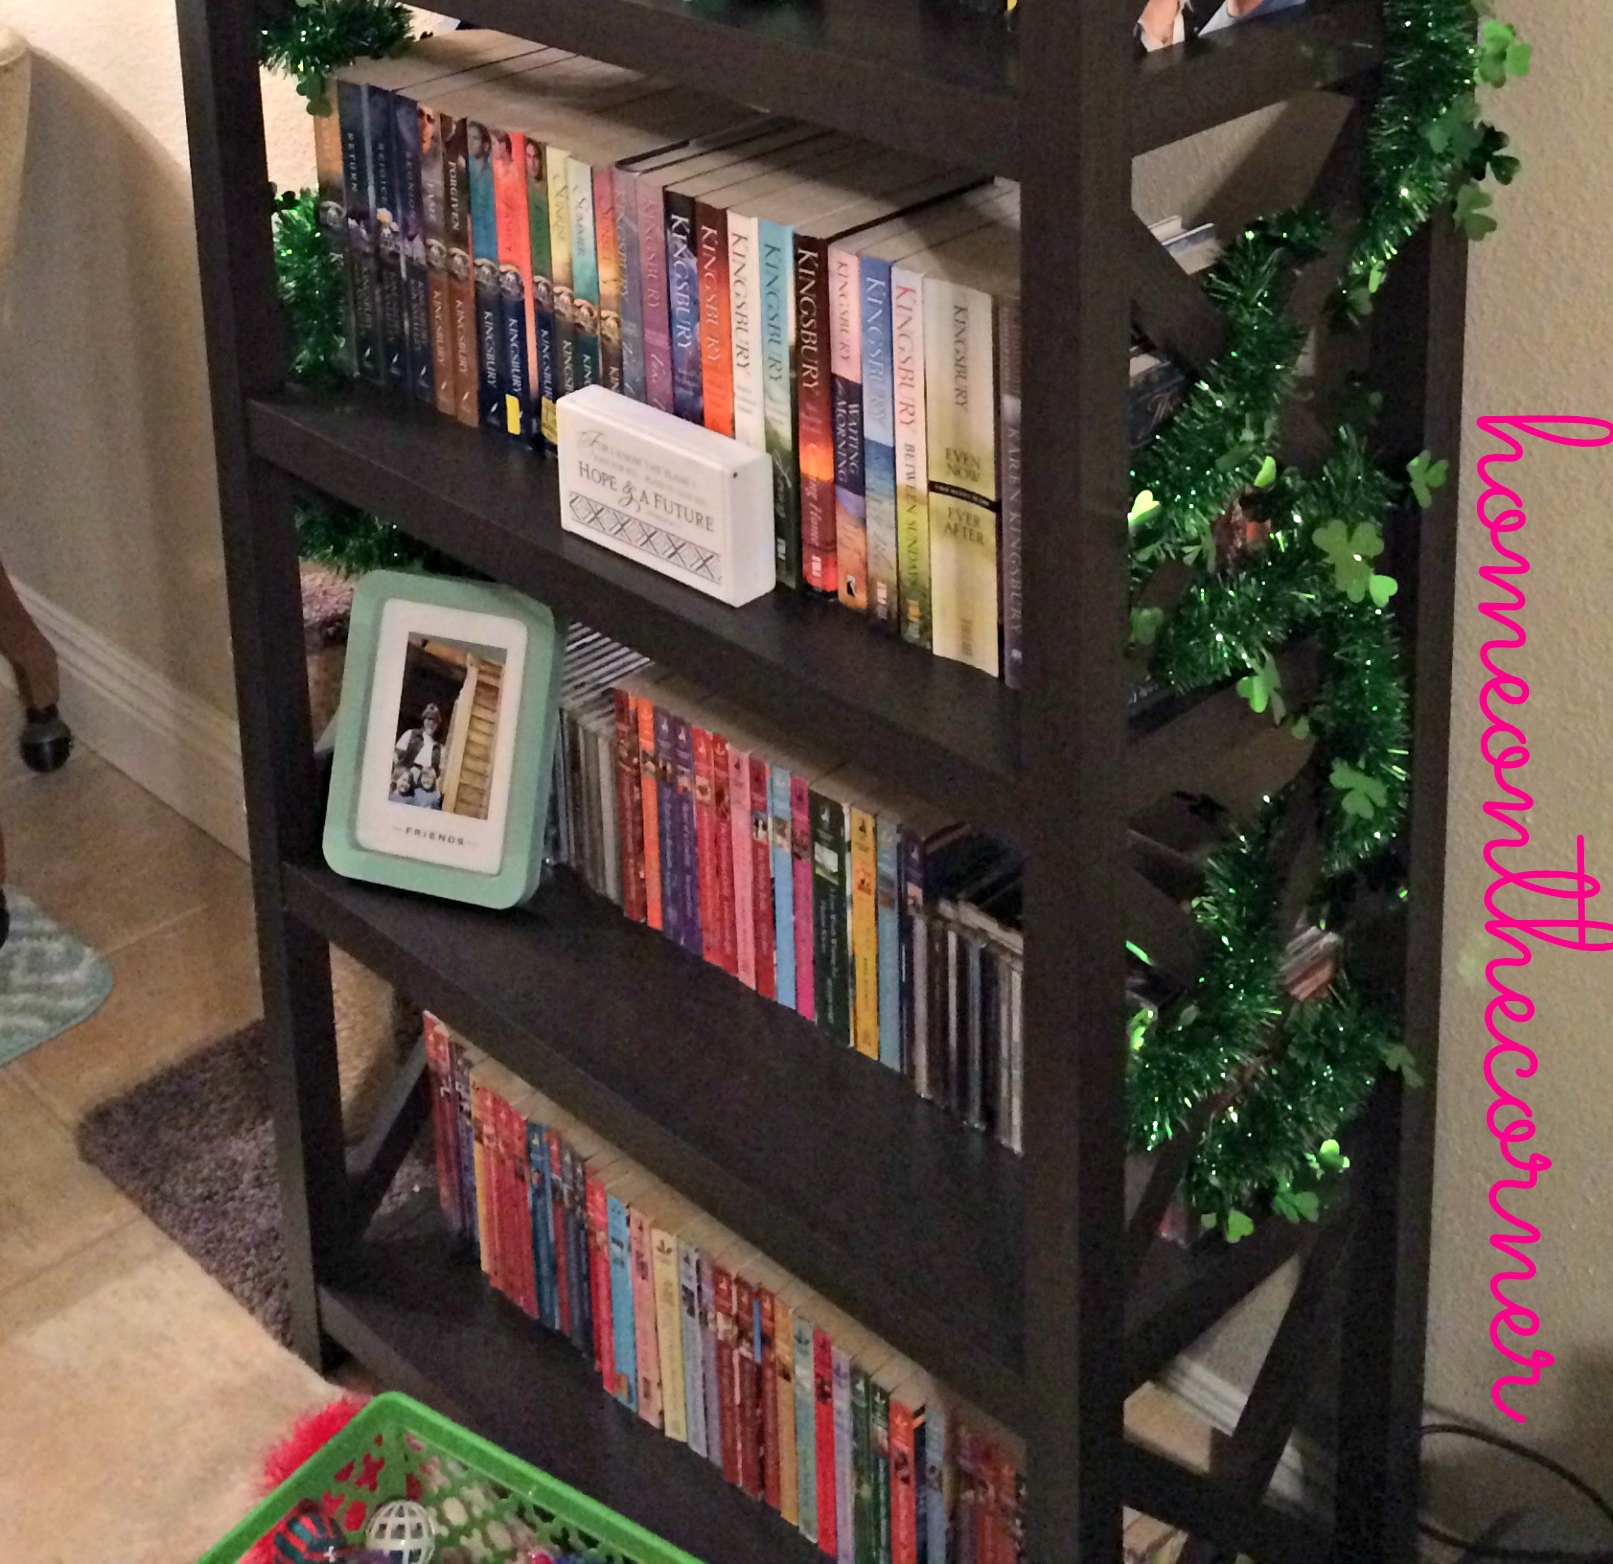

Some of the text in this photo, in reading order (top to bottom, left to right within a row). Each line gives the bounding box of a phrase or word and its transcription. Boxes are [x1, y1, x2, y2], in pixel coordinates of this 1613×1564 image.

[346, 131, 359, 192] RETURN
[377, 142, 388, 205] REJOICE
[447, 160, 460, 230] FORGIVEN
[643, 198, 662, 310] KINGSBURY
[669, 213, 693, 351] KINGSBURY
[433, 289, 447, 363] KINGSBURY
[699, 224, 720, 362] KINGSBURY
[730, 233, 750, 373] KINGSBURY
[762, 242, 783, 383] KINGSBURY
[796, 247, 822, 396] KINGSBURY
[835, 259, 855, 365] KINGSBURY
[455, 298, 470, 374] KINGSBURY
[484, 311, 498, 389] KINGSBURY
[507, 317, 522, 395] KINGSBURY
[540, 328, 554, 399] KINGSBUR
[561, 340, 574, 396] KINGSB
[864, 275, 888, 420] KINGSBURY
[895, 284, 919, 430] KINGSBURY
[952, 304, 970, 414] KINGSBURY
[835, 399, 849, 483] MORNING
[848, 402, 862, 475] WAITING
[945, 446, 980, 469] EVEN
[946, 463, 979, 483] NOW
[578, 460, 618, 491] HOPE
[618, 480, 641, 513] &
[639, 489, 650, 505] A
[653, 491, 715, 532] FUTURE
[809, 502, 823, 547] Home
[900, 442, 921, 587] BETWEEN SUNDAYS
[944, 522, 985, 546] AFTER
[948, 506, 981, 527] EVER
[1007, 426, 1022, 631] KAREN KINGSBURY
[405, 827, 464, 846] FRIENDS
